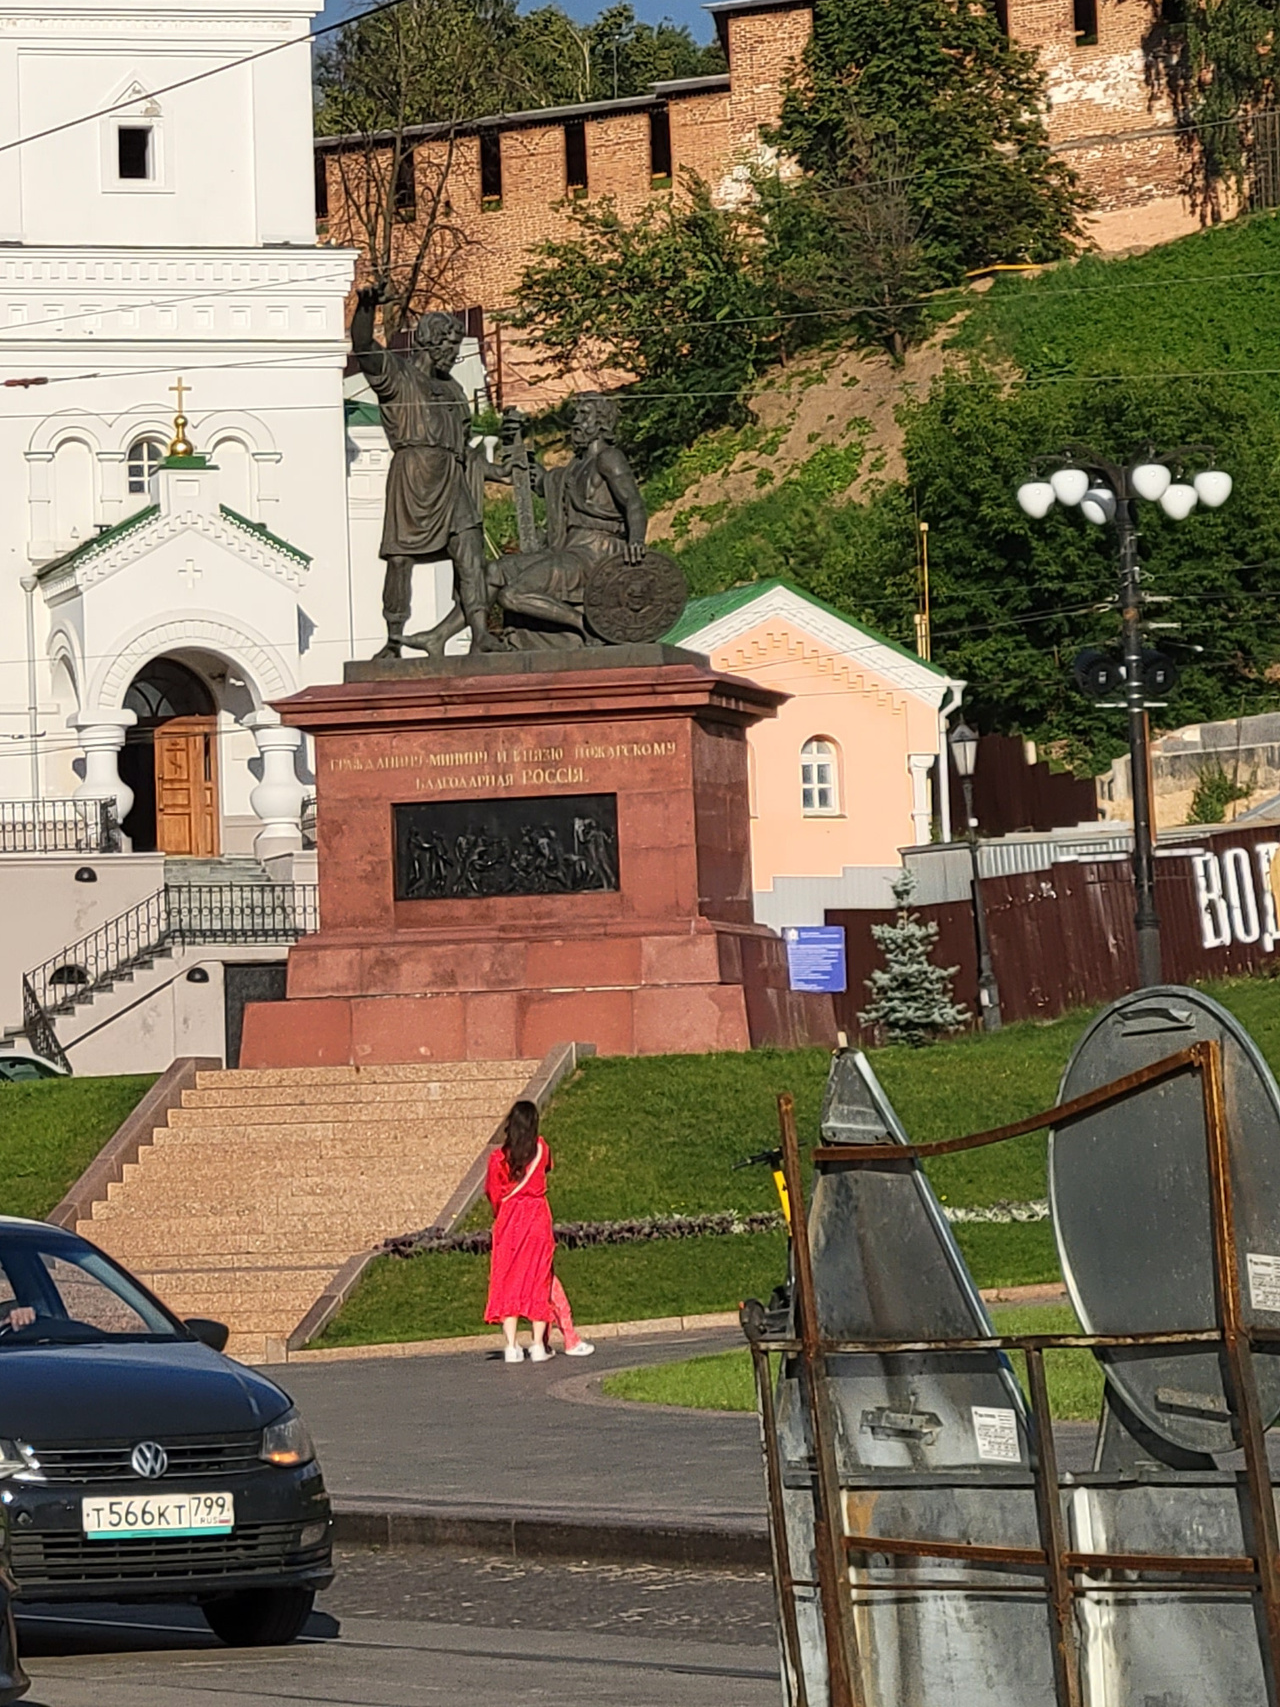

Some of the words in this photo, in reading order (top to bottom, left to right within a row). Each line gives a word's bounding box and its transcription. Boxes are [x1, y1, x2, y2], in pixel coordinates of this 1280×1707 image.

[429, 750, 488, 766] МИНИНУ
[496, 750, 507, 763] И
[191, 1496, 227, 1517] 799
[200, 1516, 218, 1525] RUS
